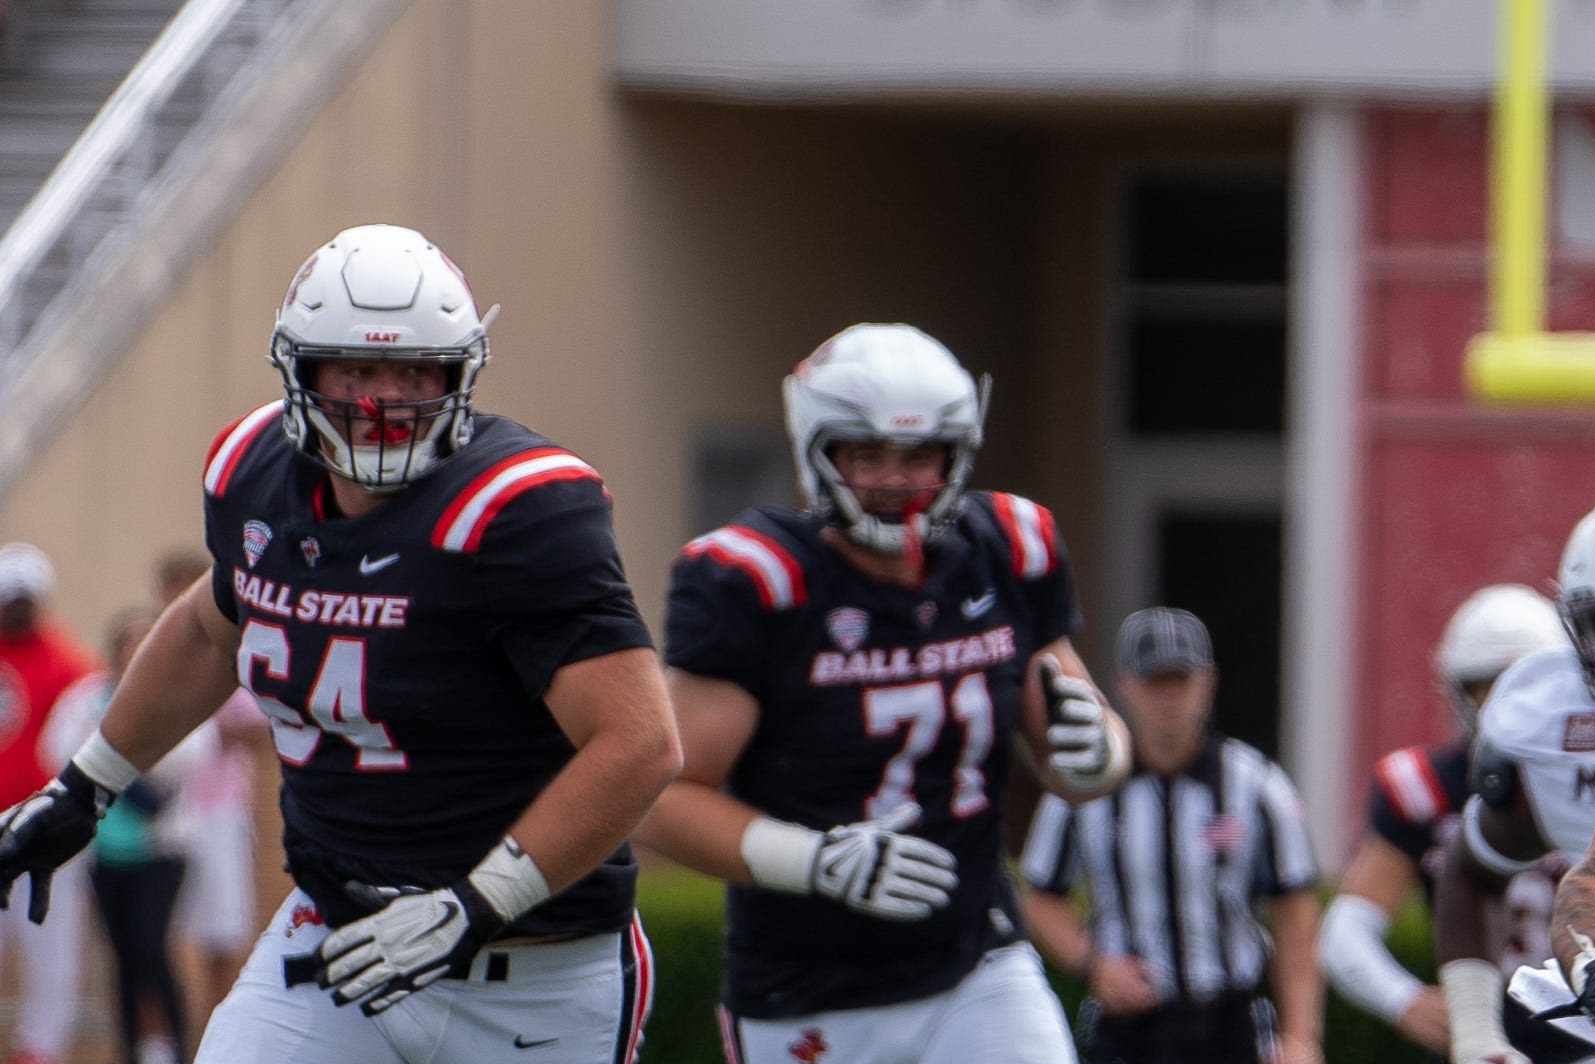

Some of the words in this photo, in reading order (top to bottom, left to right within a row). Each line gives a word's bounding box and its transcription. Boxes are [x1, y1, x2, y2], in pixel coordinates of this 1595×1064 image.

[234, 565, 293, 619] BALL
[296, 589, 409, 629] STATE
[238, 618, 410, 771] 64
[810, 648, 917, 687] BALL
[861, 671, 995, 827] 71
